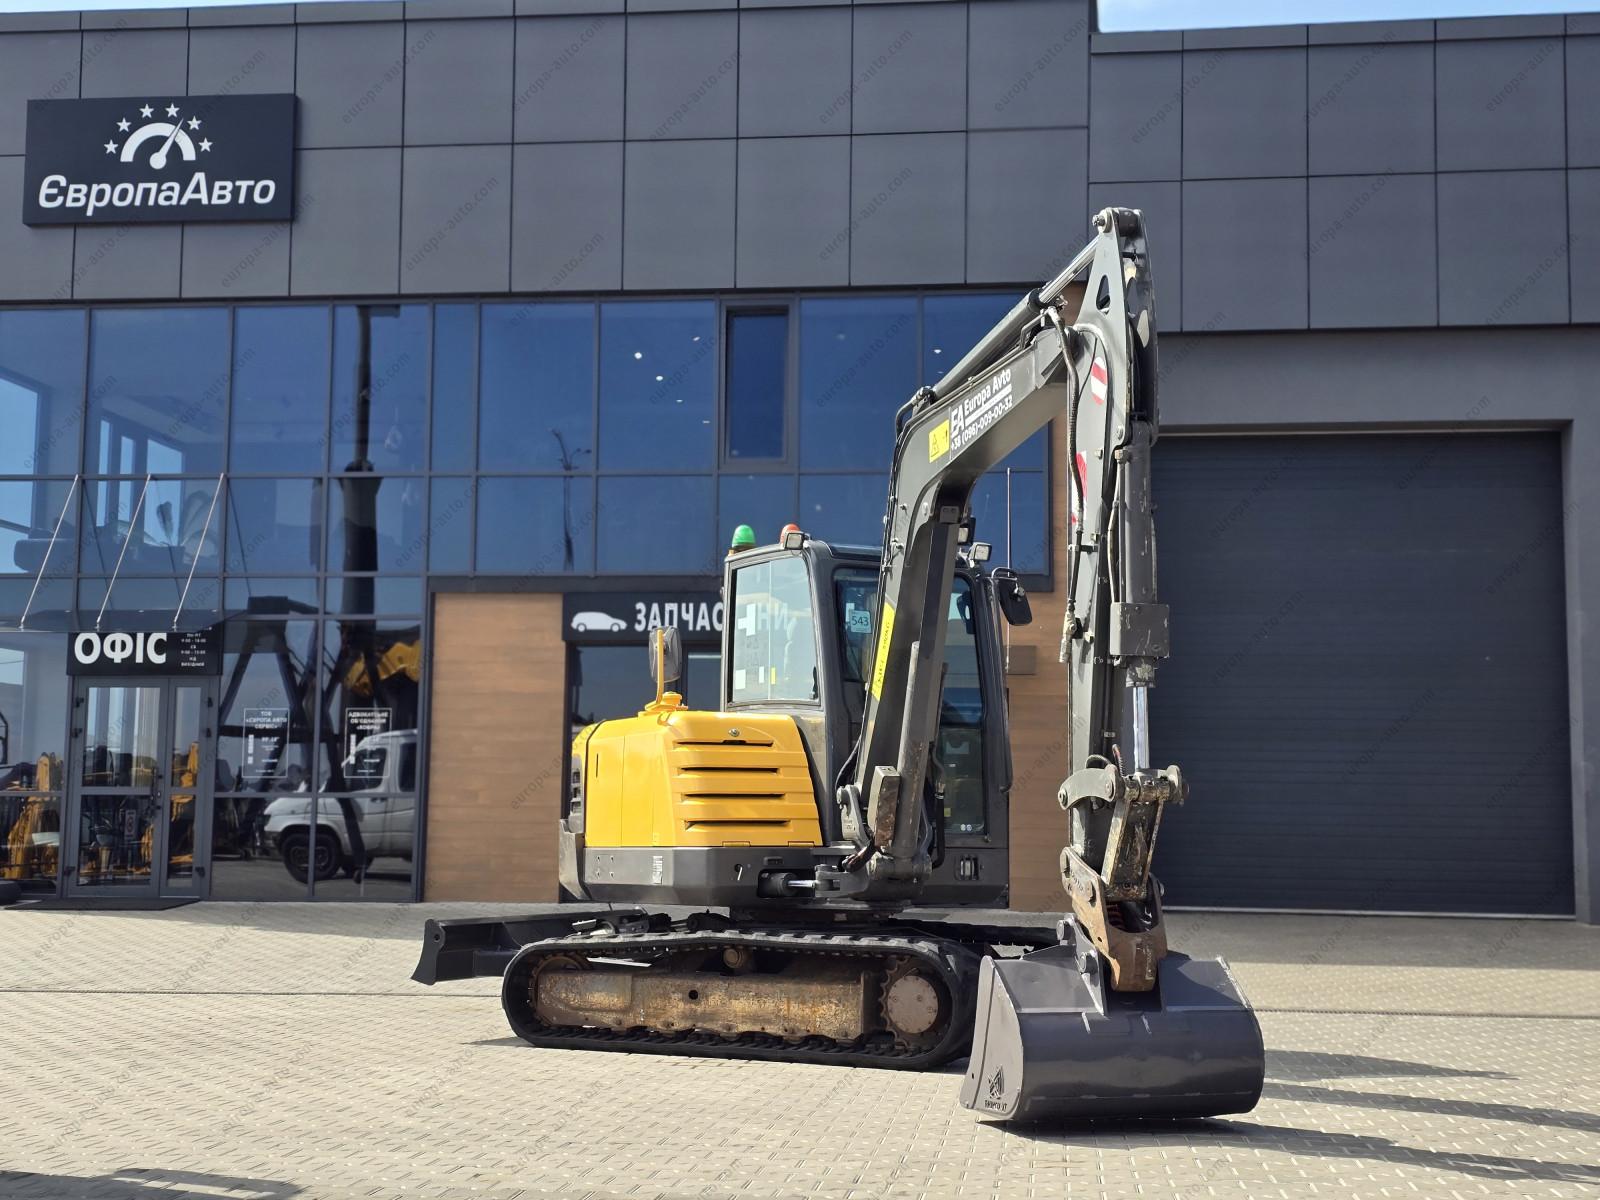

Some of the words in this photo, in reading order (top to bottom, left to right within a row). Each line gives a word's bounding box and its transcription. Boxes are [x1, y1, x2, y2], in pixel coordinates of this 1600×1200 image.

[38, 172, 276, 216] ЄвропаАвто
[963, 384, 991, 416] Europa
[992, 368, 1011, 393] Avto
[851, 615, 869, 626] 543
[74, 632, 168, 664] ОФІС
